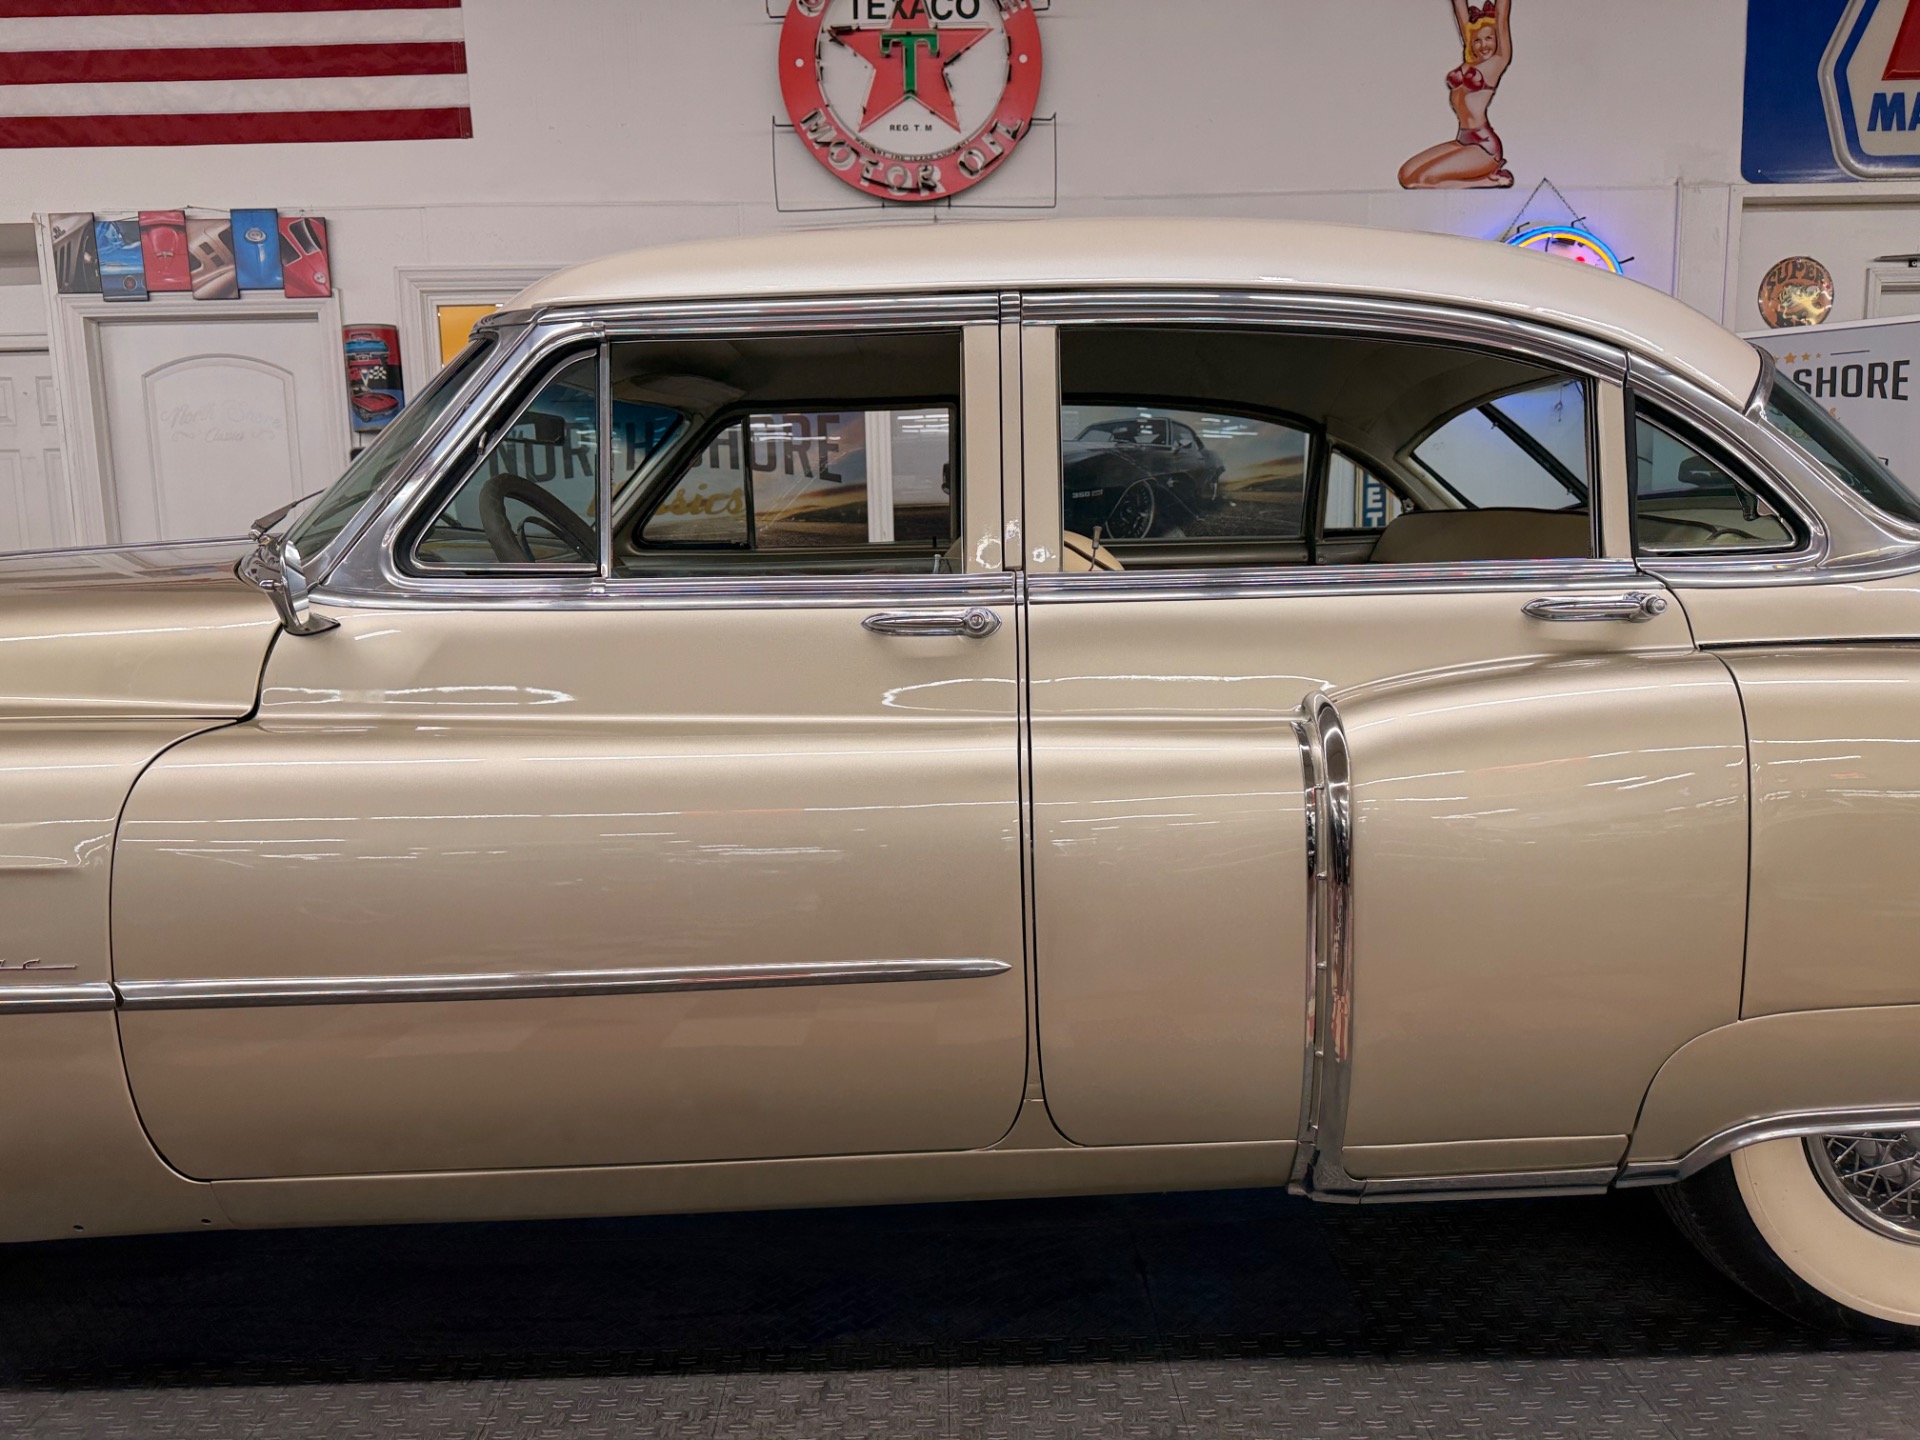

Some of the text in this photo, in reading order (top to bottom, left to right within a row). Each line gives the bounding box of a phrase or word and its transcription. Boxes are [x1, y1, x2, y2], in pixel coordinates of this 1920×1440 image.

[852, 0, 980, 20] TEXACO
[800, 107, 1024, 196] MOTOR OIL
[1766, 261, 1825, 286] SUPER
[1793, 360, 1910, 400] SHORE
[489, 414, 842, 484] NORH HORE
